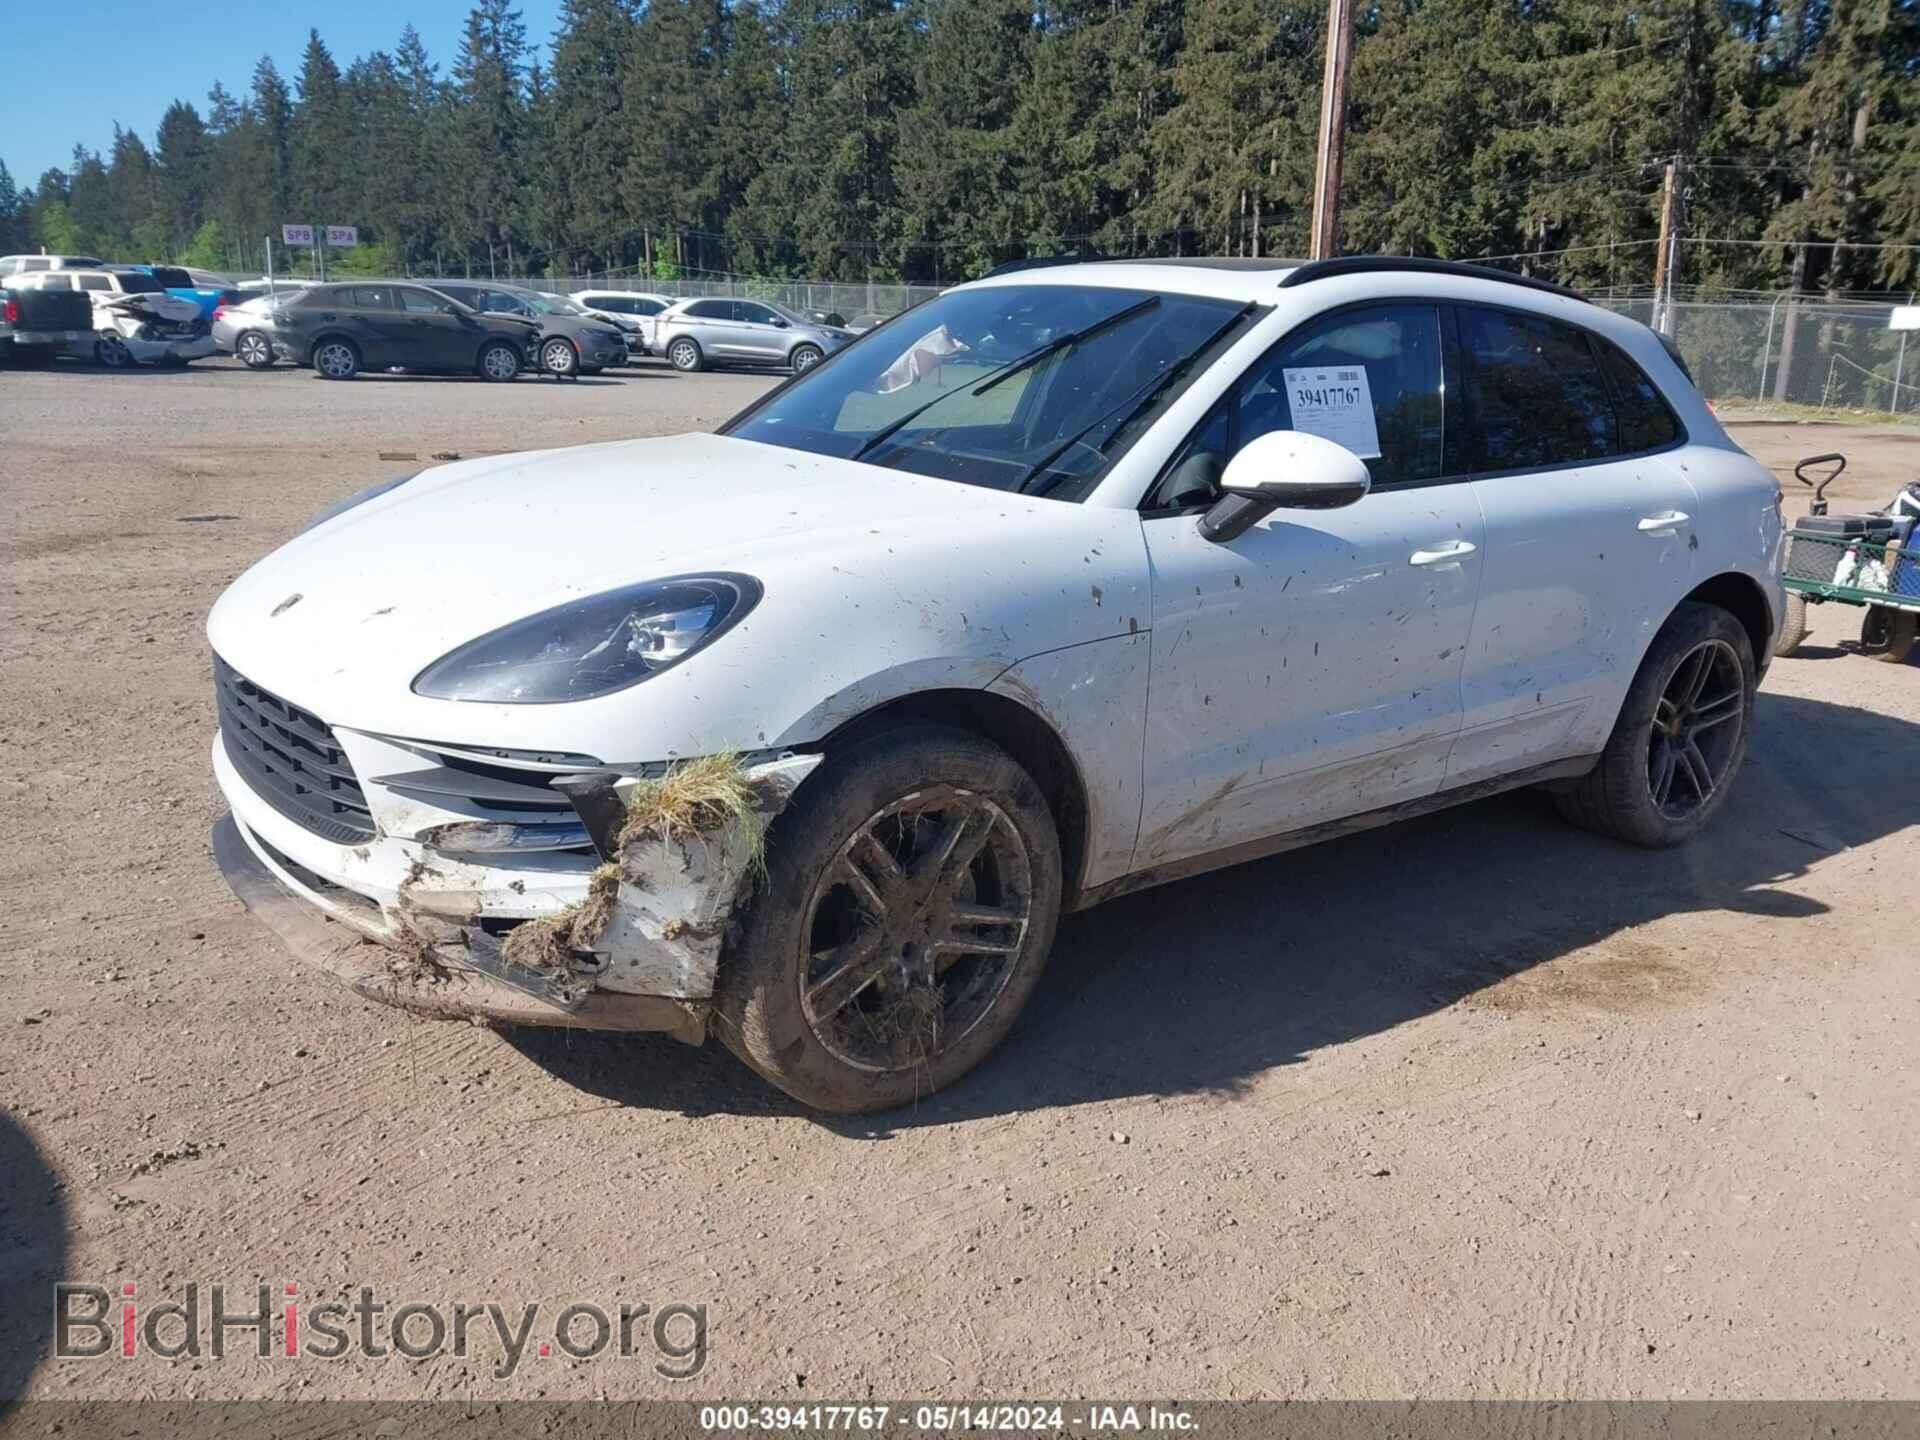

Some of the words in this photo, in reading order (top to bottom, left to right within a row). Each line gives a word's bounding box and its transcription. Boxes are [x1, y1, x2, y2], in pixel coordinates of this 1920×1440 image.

[287, 230, 311, 241] SPB
[331, 230, 354, 241] SPA
[1296, 387, 1360, 408] 39417767
